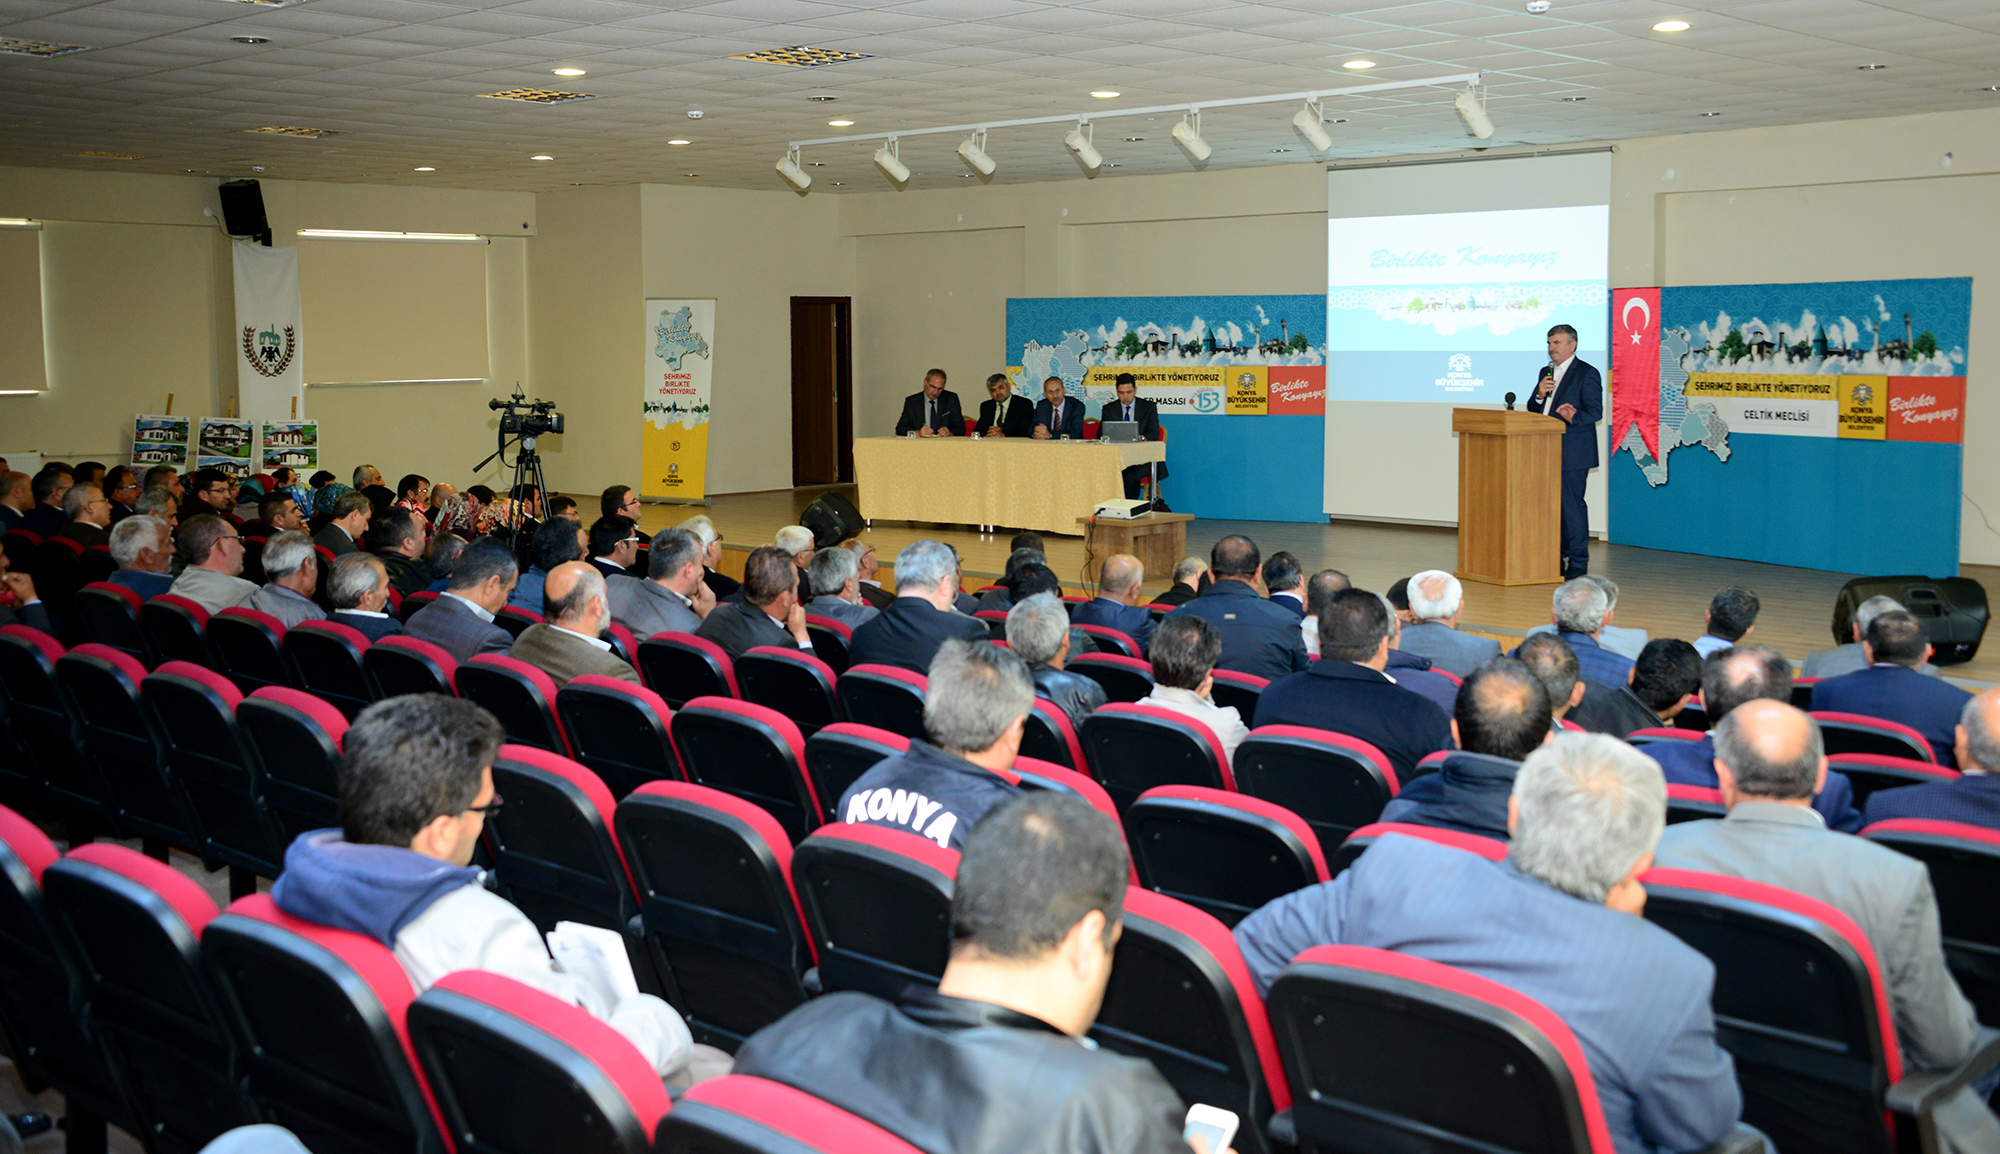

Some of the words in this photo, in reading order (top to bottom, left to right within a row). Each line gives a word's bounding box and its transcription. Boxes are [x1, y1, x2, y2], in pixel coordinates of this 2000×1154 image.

[1369, 248, 1447, 269] Birlikte
[1456, 246, 1560, 270] Konyayız
[1270, 379, 1309, 393] Birlikte
[1280, 389, 1326, 403] Konyayız
[1889, 393, 1937, 411] Birlikte
[1744, 408, 1773, 420] ÇELTİK
[1775, 409, 1810, 421] MECLİSİ
[1900, 407, 1959, 425] Konyayız
[846, 787, 958, 849] KONYA
